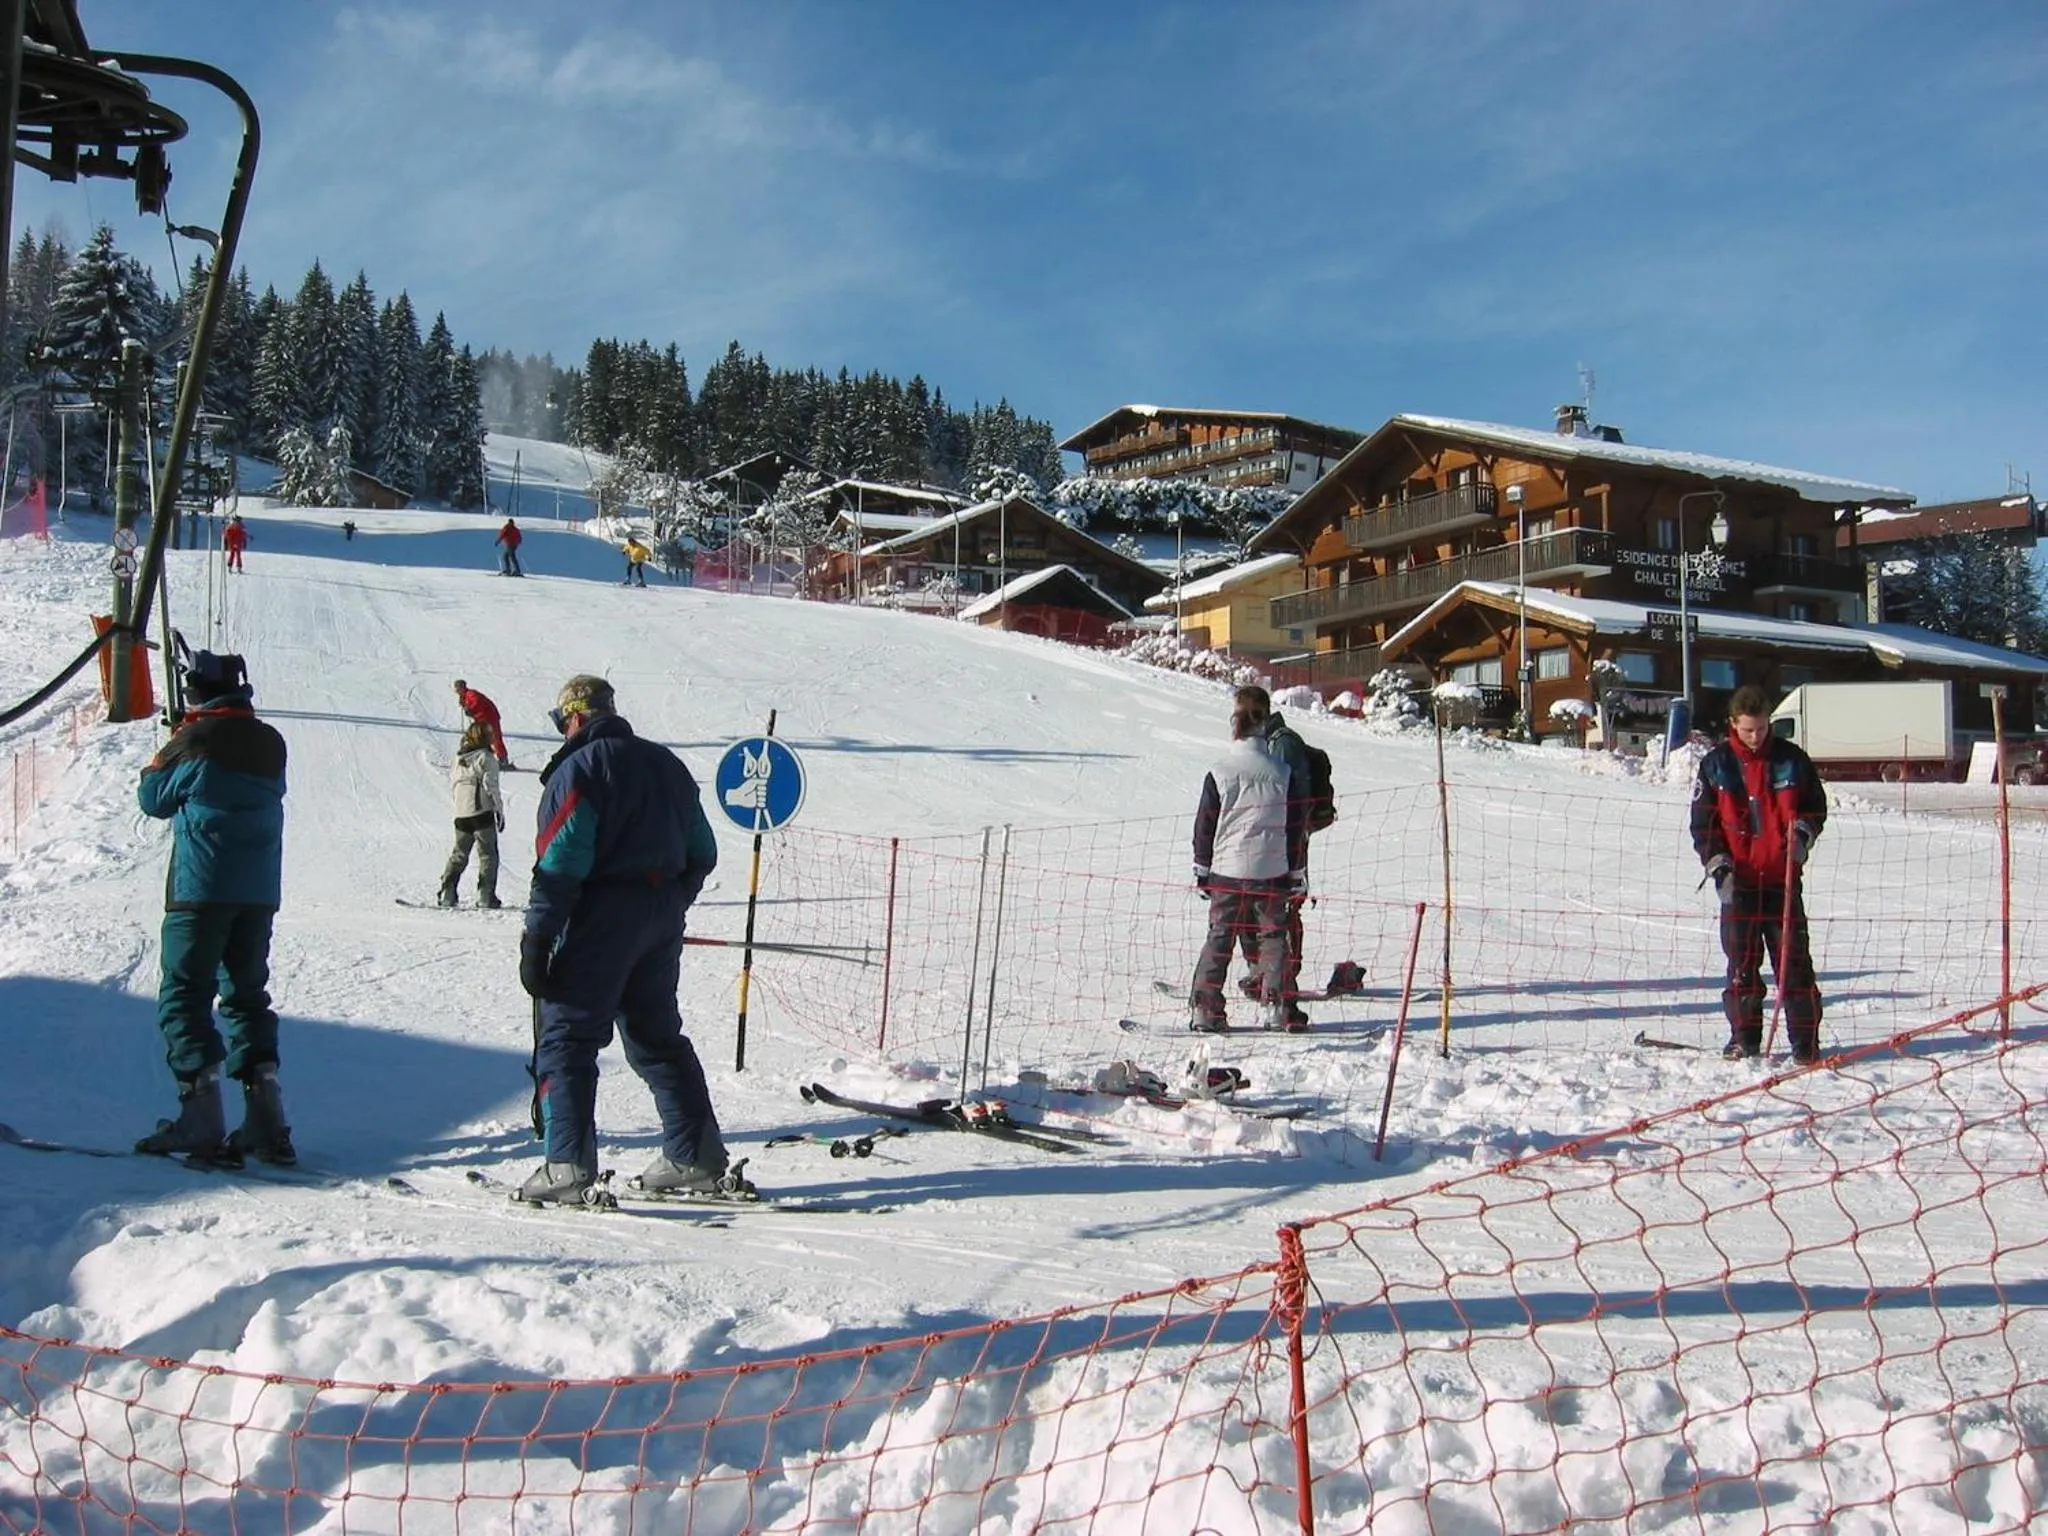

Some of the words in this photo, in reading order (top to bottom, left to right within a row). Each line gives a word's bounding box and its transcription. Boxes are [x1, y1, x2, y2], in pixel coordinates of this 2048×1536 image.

[1616, 550, 1669, 568] ESIDENCE
[1634, 570, 1678, 586] CHALET
[1683, 577, 1726, 592] ABRIEL
[1651, 613, 1696, 628] LOCATN
[1651, 628, 1664, 641] DE
